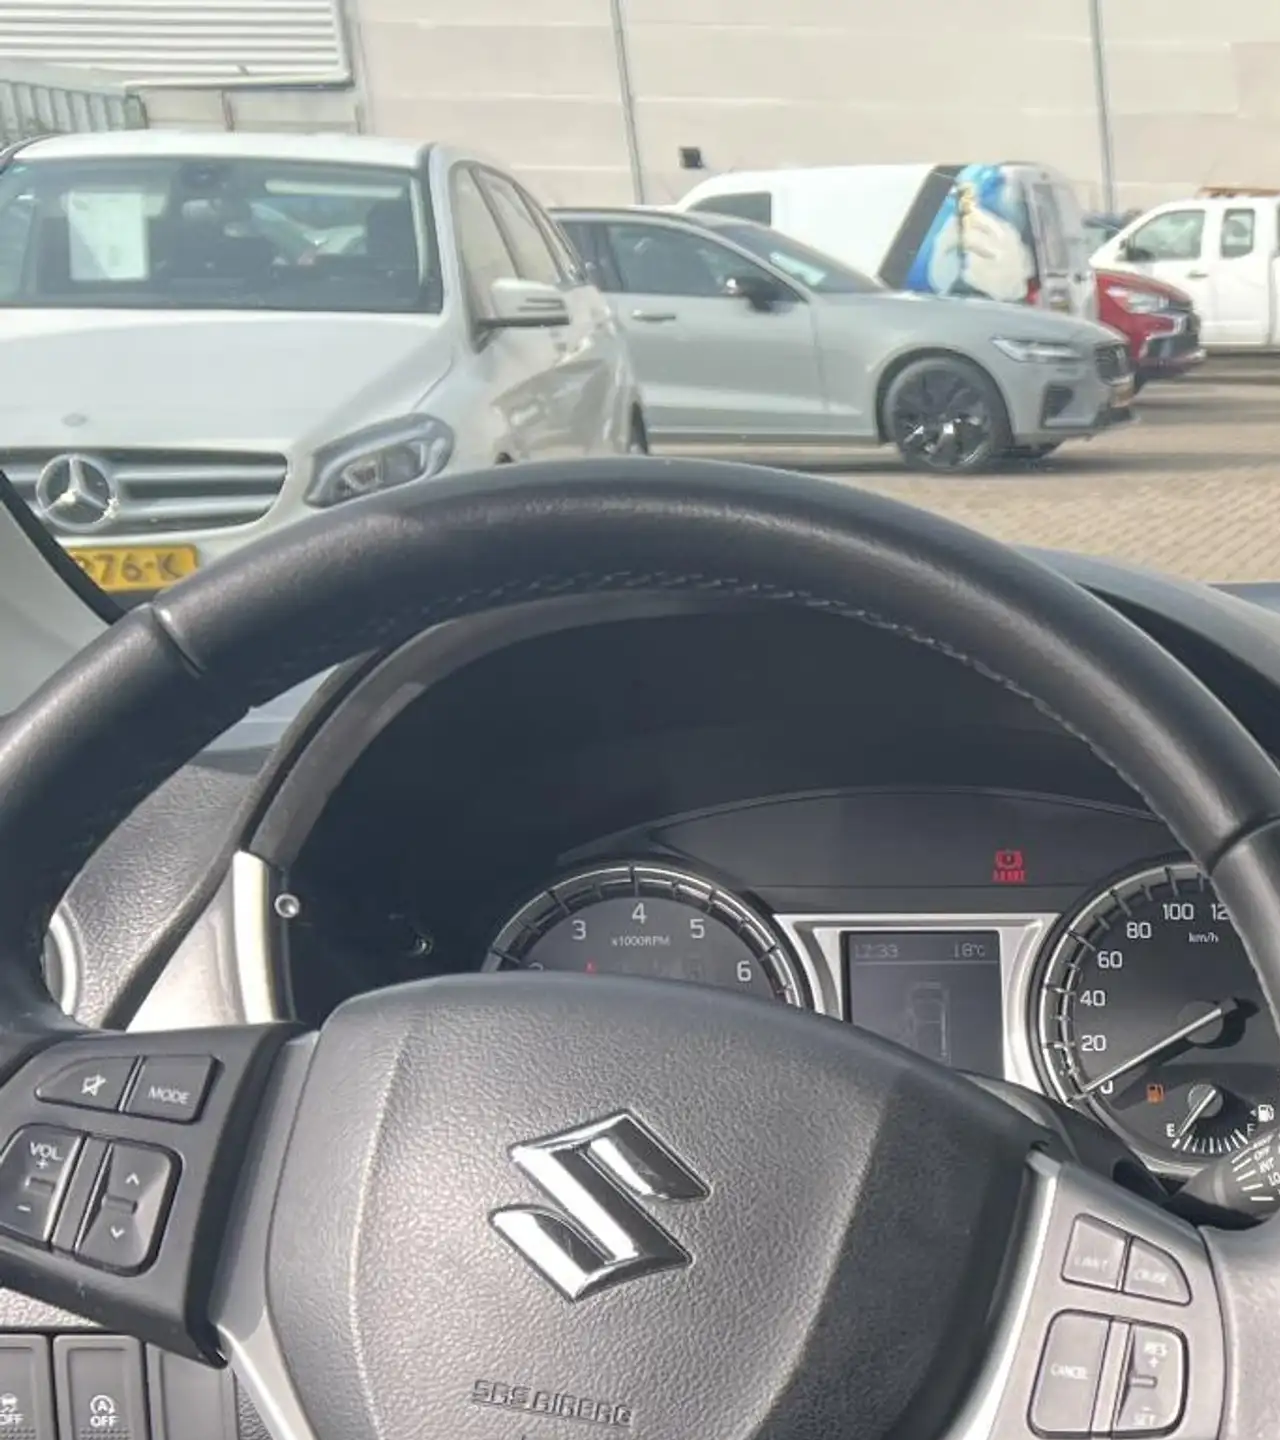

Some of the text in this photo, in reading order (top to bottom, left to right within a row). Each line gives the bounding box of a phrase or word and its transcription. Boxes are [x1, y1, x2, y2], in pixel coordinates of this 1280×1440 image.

[632, 903, 647, 924] 4
[1162, 903, 1194, 920] 100
[572, 920, 587, 940] 3
[690, 918, 705, 939] 5
[1126, 922, 1152, 939] 80
[1188, 931, 1219, 943] km/h
[1097, 951, 1123, 968] 60
[736, 960, 752, 982] 6
[1080, 990, 1106, 1006] 40
[1081, 1035, 1107, 1051] 20
[149, 1087, 190, 1105] MODE
[1166, 1123, 1175, 1138] E
[30, 1141, 64, 1161] VOL
[90, 1415, 118, 1427] OFF
